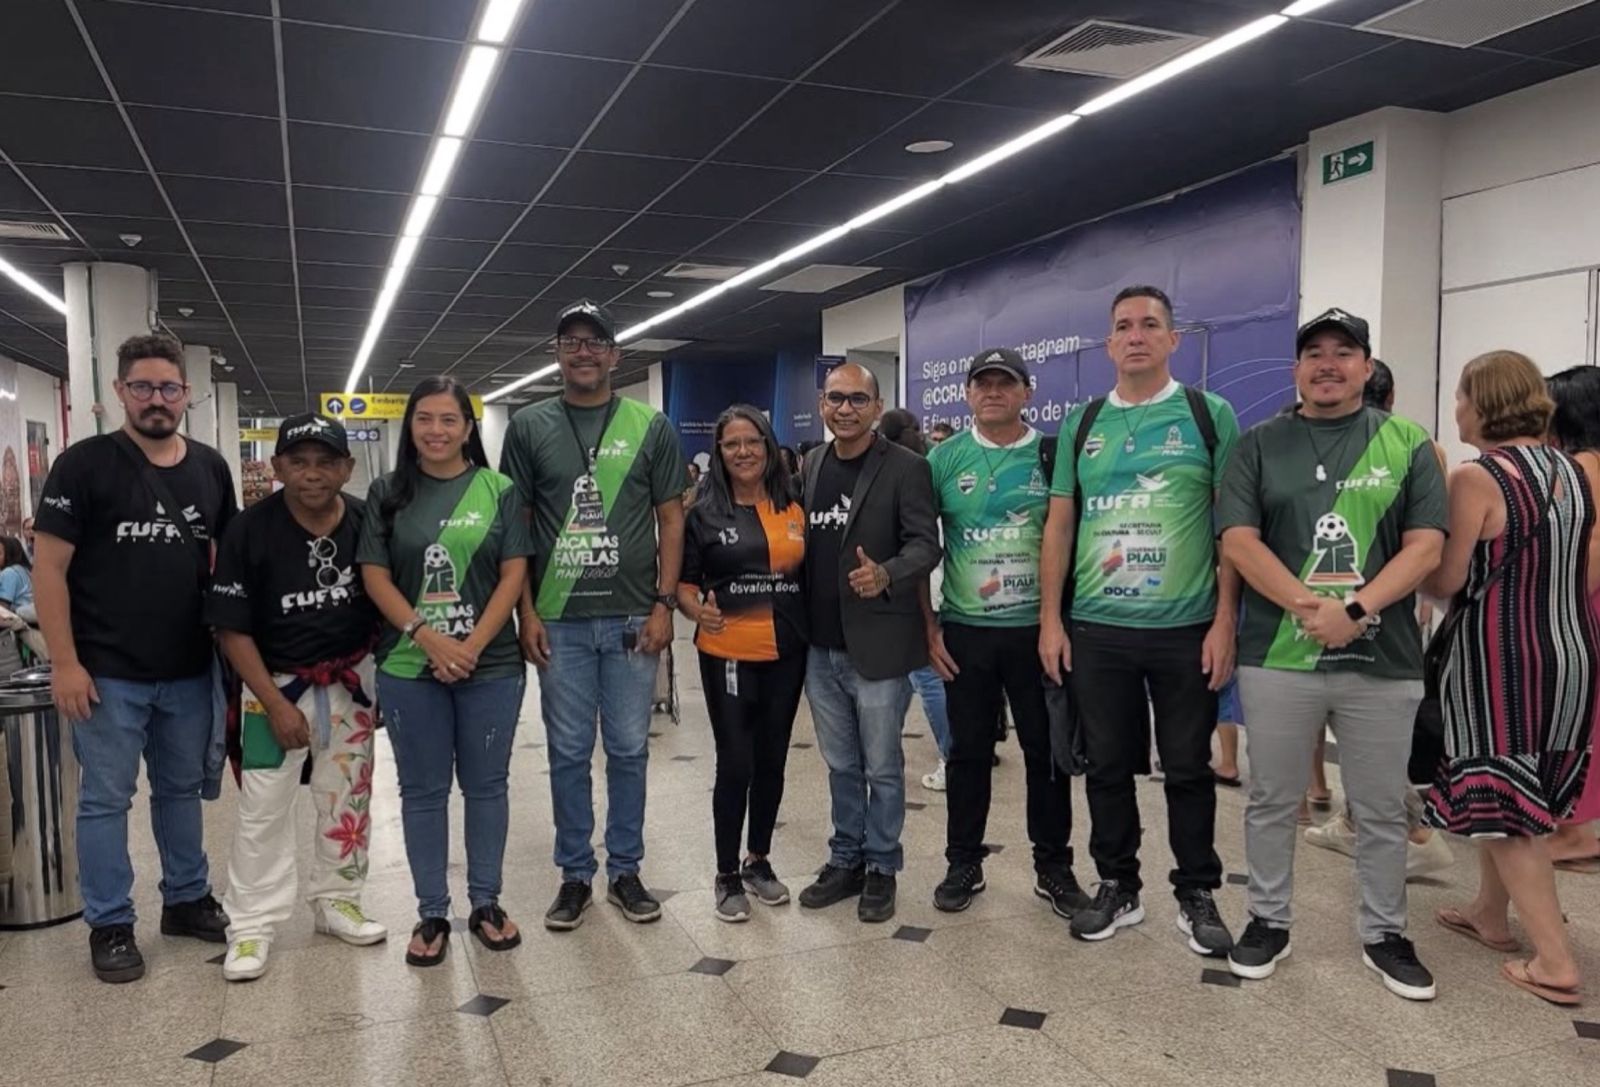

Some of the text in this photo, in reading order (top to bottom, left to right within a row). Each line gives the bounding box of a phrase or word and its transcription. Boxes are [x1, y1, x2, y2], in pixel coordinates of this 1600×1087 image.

[922, 360, 947, 382] Siga
[949, 361, 957, 374] o
[922, 416, 929, 434] E
[1041, 399, 1062, 422] de
[1087, 493, 1151, 511] CUFA
[809, 511, 849, 525] UFA
[116, 521, 182, 538] CUFA
[718, 527, 740, 546] 13
[963, 527, 1020, 541] CUFA
[591, 535, 619, 549] DAS
[554, 550, 620, 567] FAVELAS
[729, 581, 774, 595] Osvaldo
[281, 586, 349, 609] CUFA
[446, 604, 474, 619] DAS
